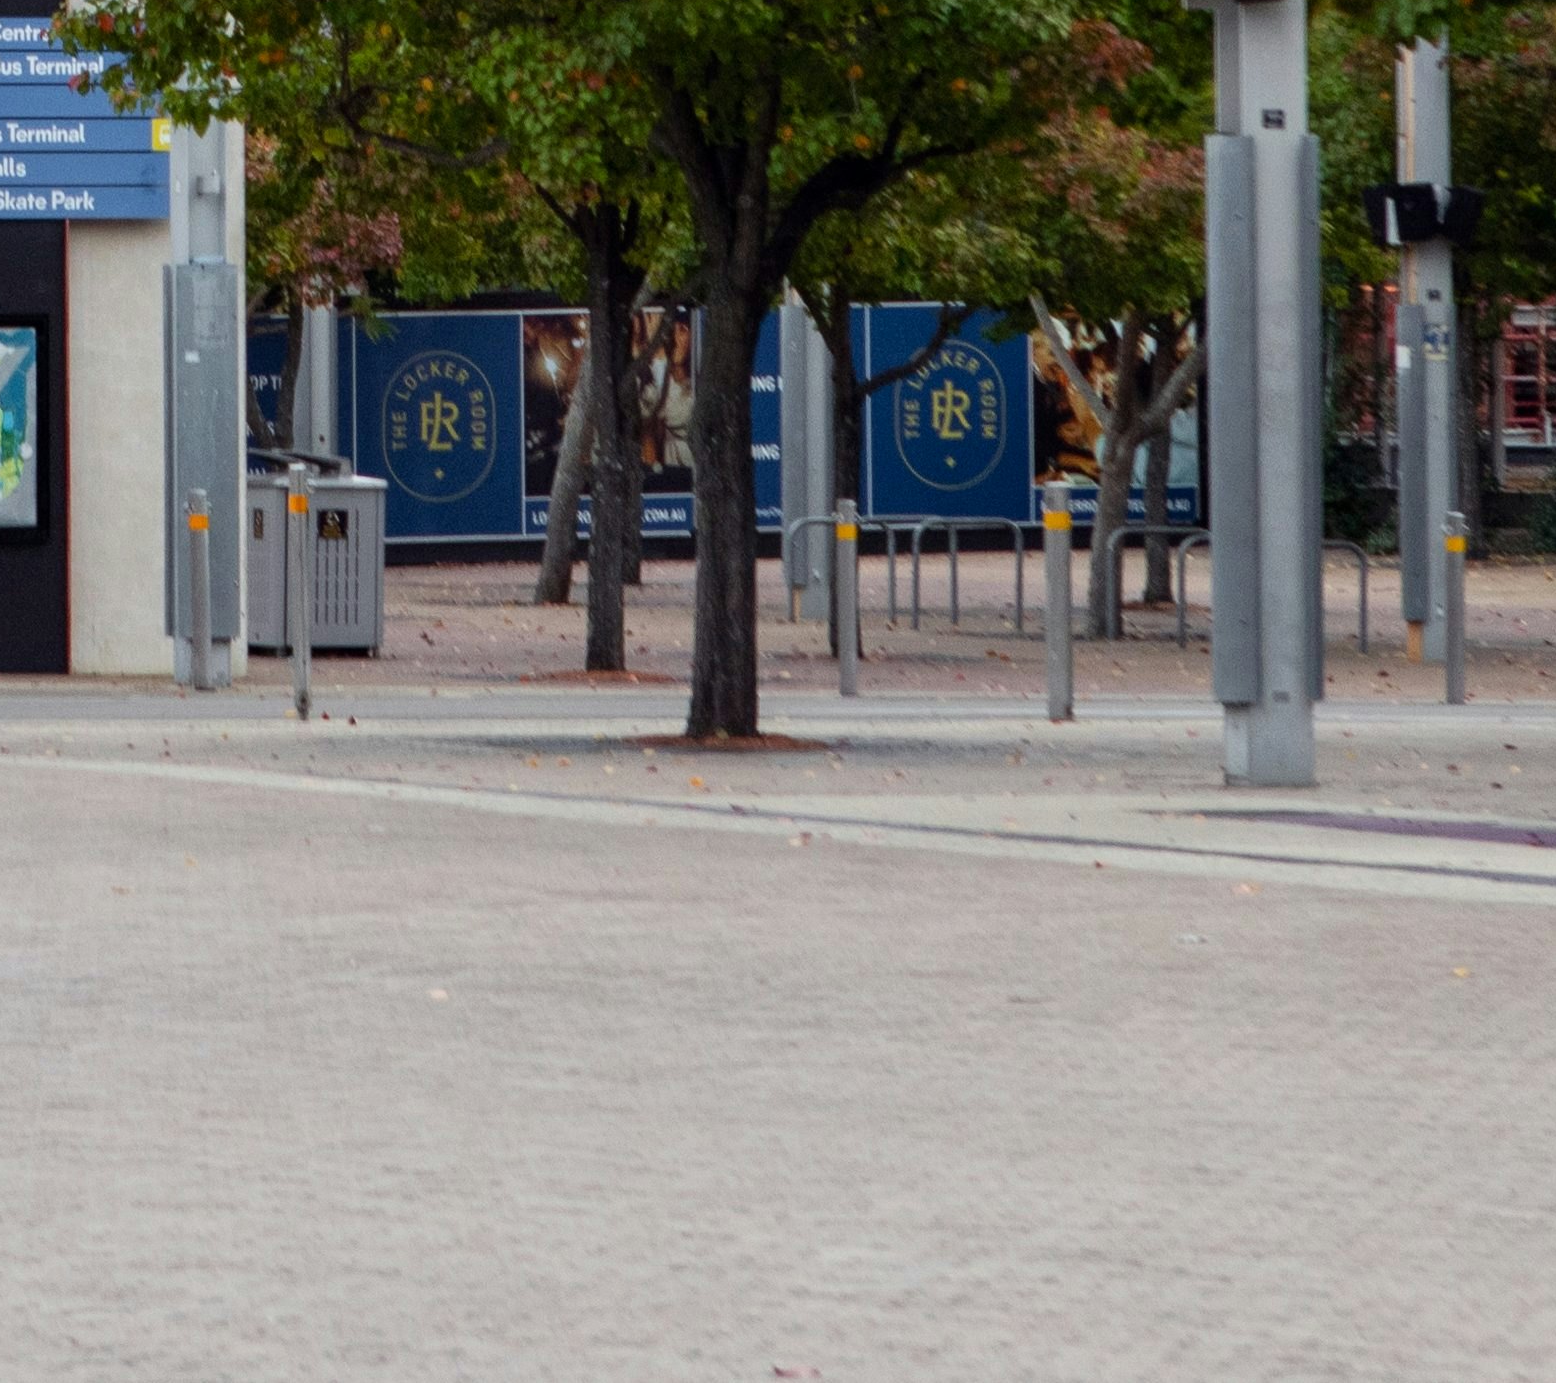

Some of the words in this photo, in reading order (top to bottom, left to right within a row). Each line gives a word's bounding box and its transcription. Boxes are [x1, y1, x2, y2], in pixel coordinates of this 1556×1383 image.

[26, 55, 104, 76] Terminal
[7, 123, 85, 143] Terminal
[51, 190, 95, 210] Park
[396, 360, 470, 402] LOCKER
[469, 389, 487, 451] ROOM
[904, 398, 920, 439] THE
[978, 378, 997, 439] ROOM
[391, 410, 407, 450] THE
